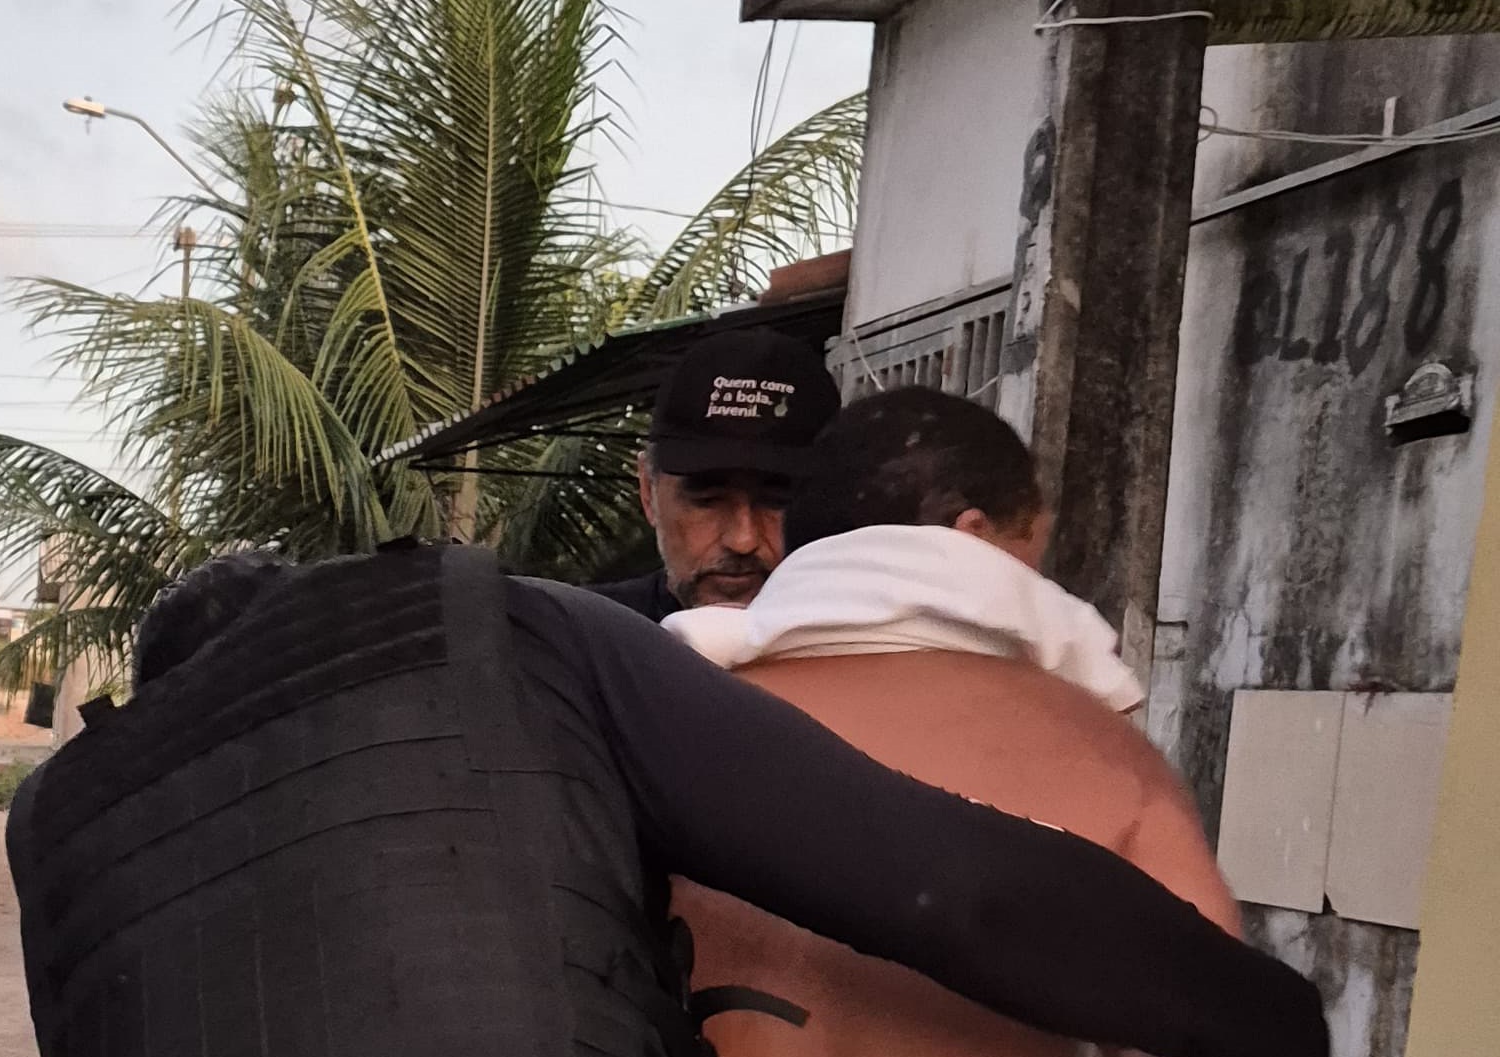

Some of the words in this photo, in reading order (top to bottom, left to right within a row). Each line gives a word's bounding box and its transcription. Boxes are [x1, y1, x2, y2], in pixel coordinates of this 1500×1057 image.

[714, 376, 757, 389] Quem
[760, 381, 795, 394] corre
[710, 389, 720, 401] é
[723, 392, 733, 402] a
